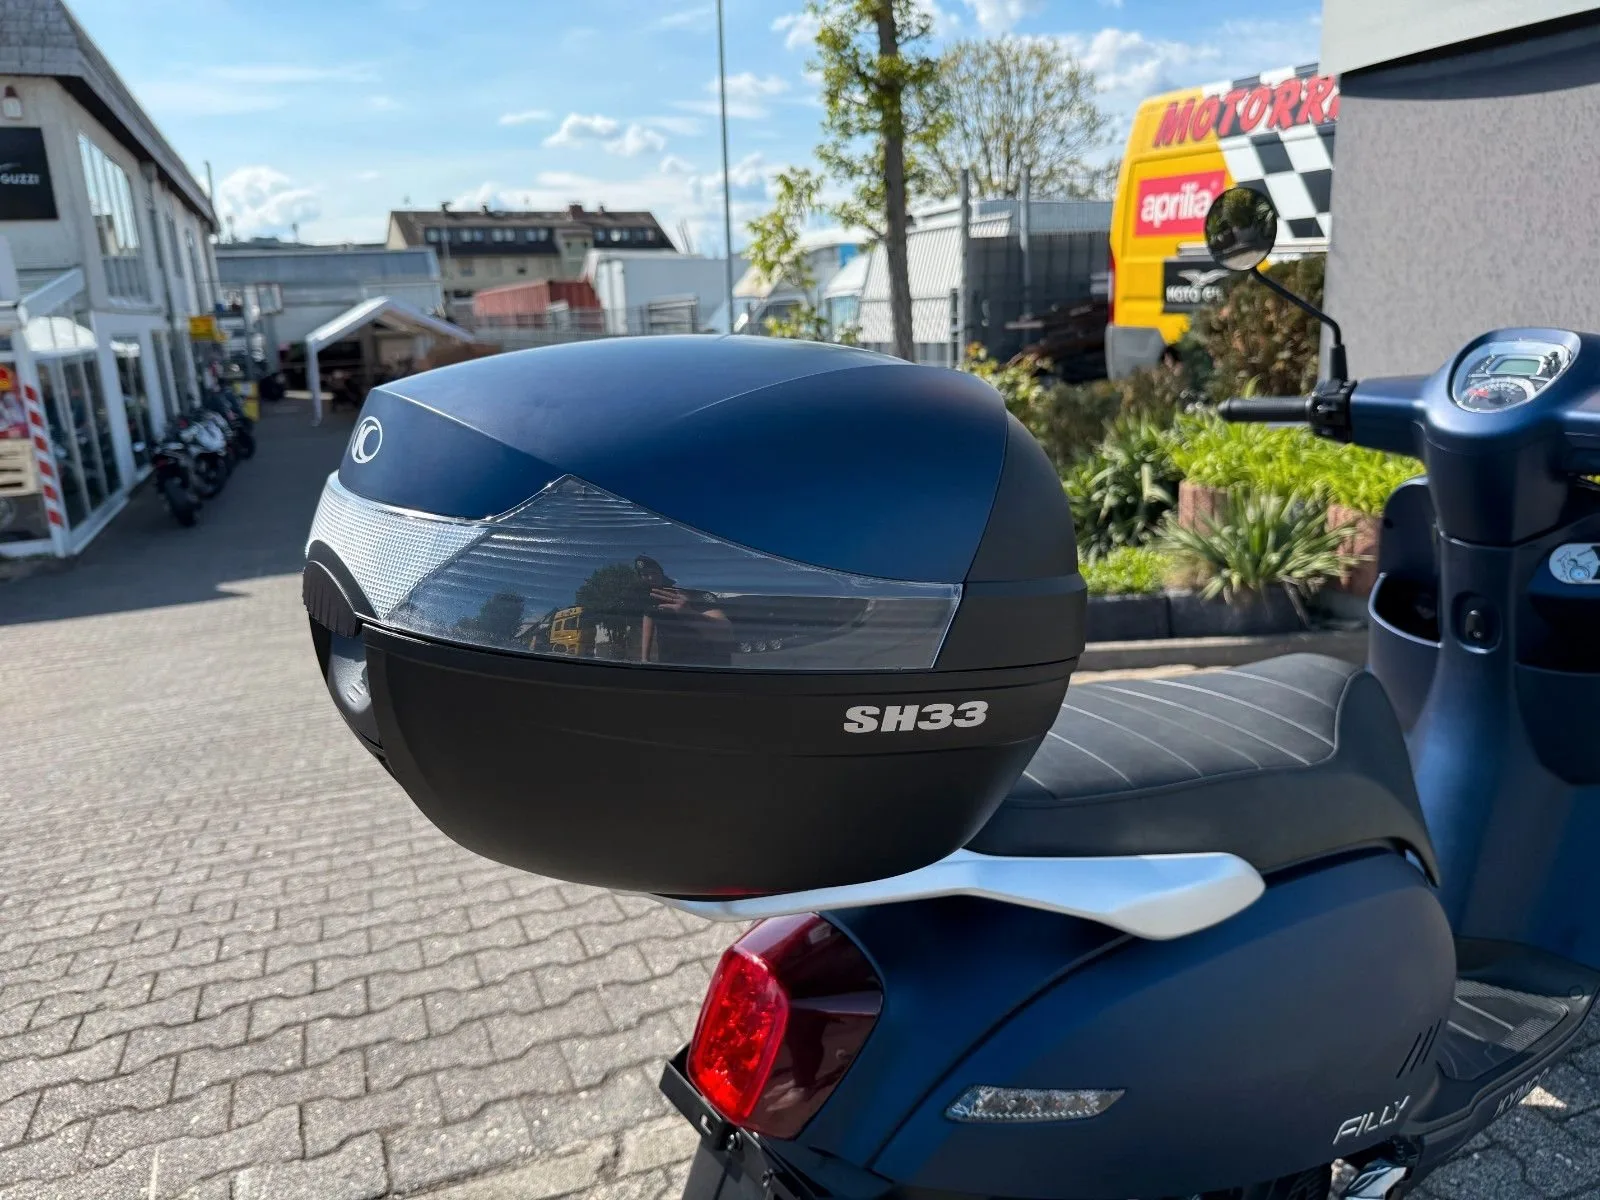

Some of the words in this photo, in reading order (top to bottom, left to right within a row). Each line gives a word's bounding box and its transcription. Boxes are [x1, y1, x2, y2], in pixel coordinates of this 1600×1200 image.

[1140, 181, 1212, 229] aprilia
[1166, 285, 1201, 303] MOTO
[843, 700, 989, 734] SH33
[1332, 1095, 1410, 1145] FILLY
